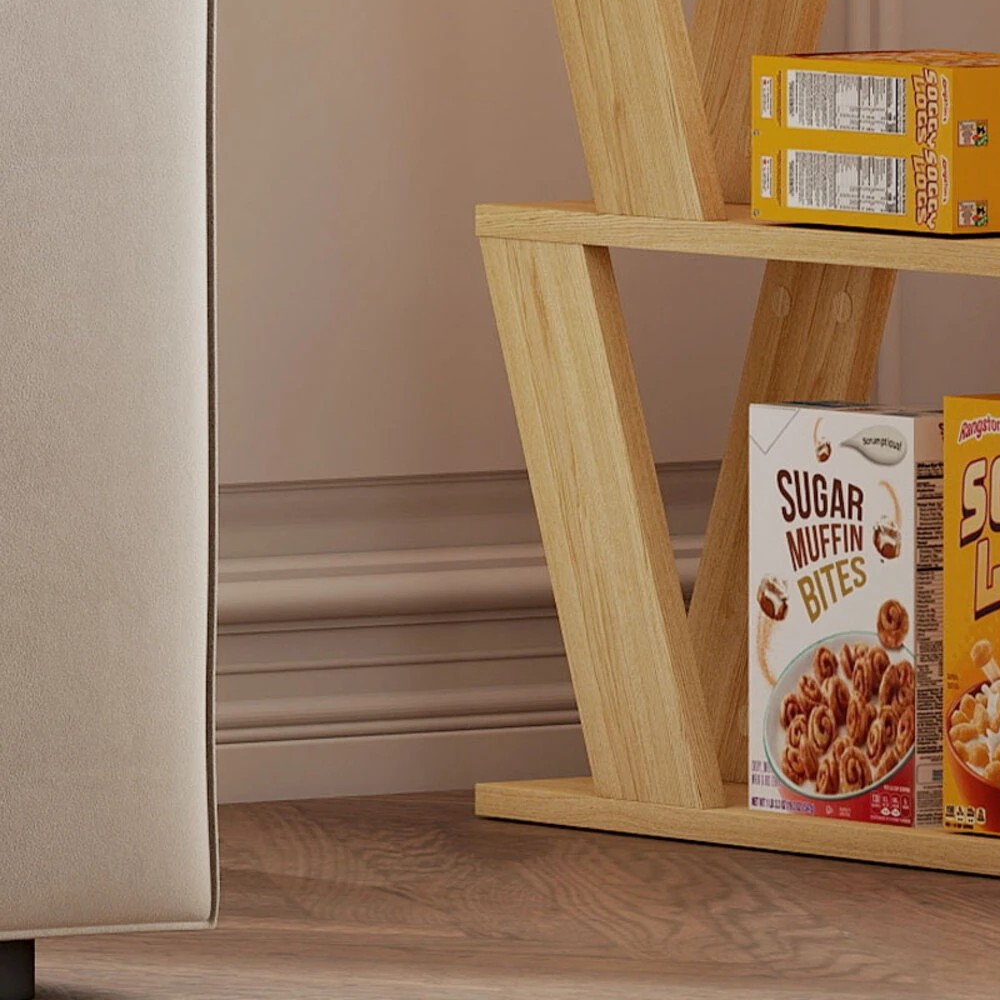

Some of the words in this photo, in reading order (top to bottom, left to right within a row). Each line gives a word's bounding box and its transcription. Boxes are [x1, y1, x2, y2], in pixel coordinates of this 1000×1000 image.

[911, 74, 927, 145] LOGS
[922, 67, 939, 148] SOGGY
[911, 154, 927, 225] LOGS
[922, 147, 939, 228] SOGGY
[777, 469, 864, 522] SUGAR
[786, 523, 863, 571] MUFFIN
[797, 556, 867, 623] BITES
